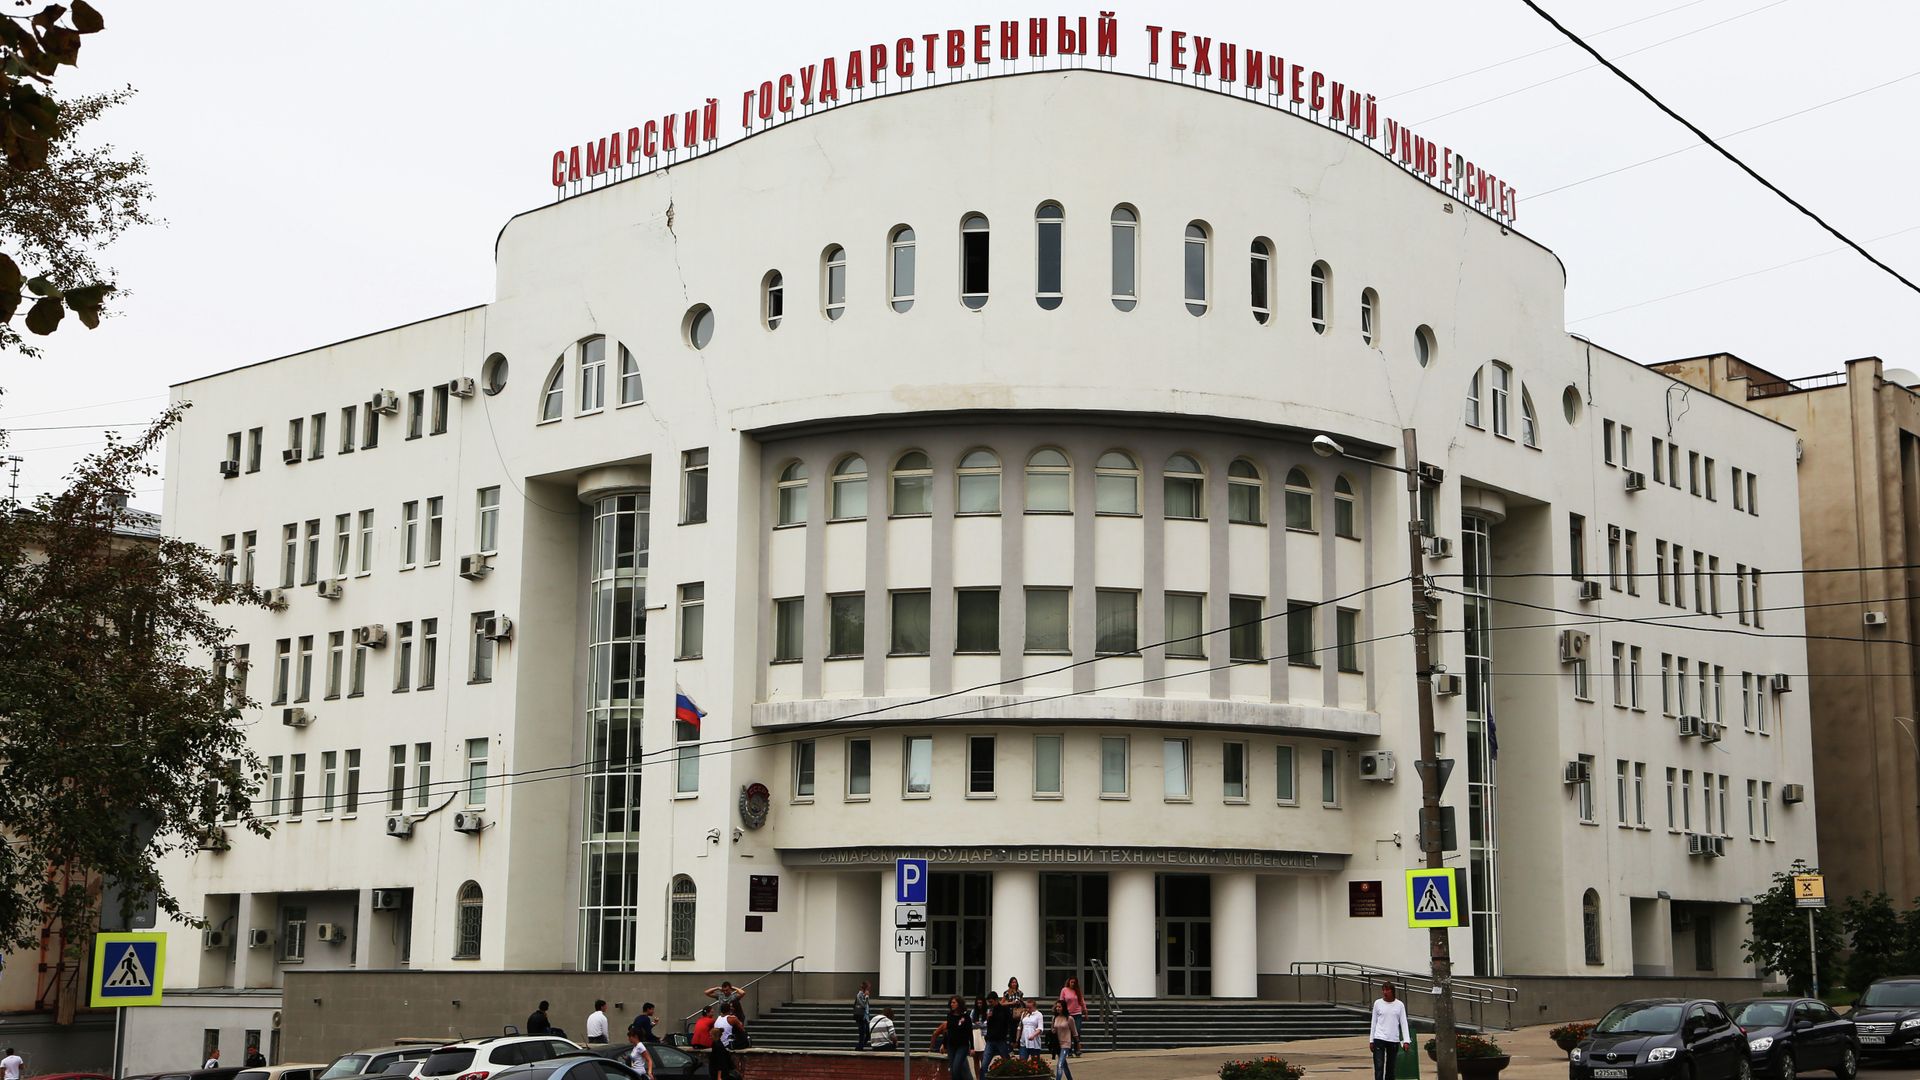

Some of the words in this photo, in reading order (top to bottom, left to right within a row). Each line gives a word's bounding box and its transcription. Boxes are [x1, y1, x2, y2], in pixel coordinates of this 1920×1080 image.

[552, 98, 719, 187] САМАРСКИЙ
[742, 11, 1117, 128] ГОСУДАРСТВЕННЫЙ
[1146, 25, 1377, 140] ТЕХНИЧЕСКИЙ
[1384, 117, 1517, 222] УНИВЕРСИТЕТ
[916, 848, 1094, 863] ОСУДАРТВЕННЫЙ
[1099, 849, 1219, 864] ТЕХНИЧЕСКИЙ
[903, 863, 921, 898] P
